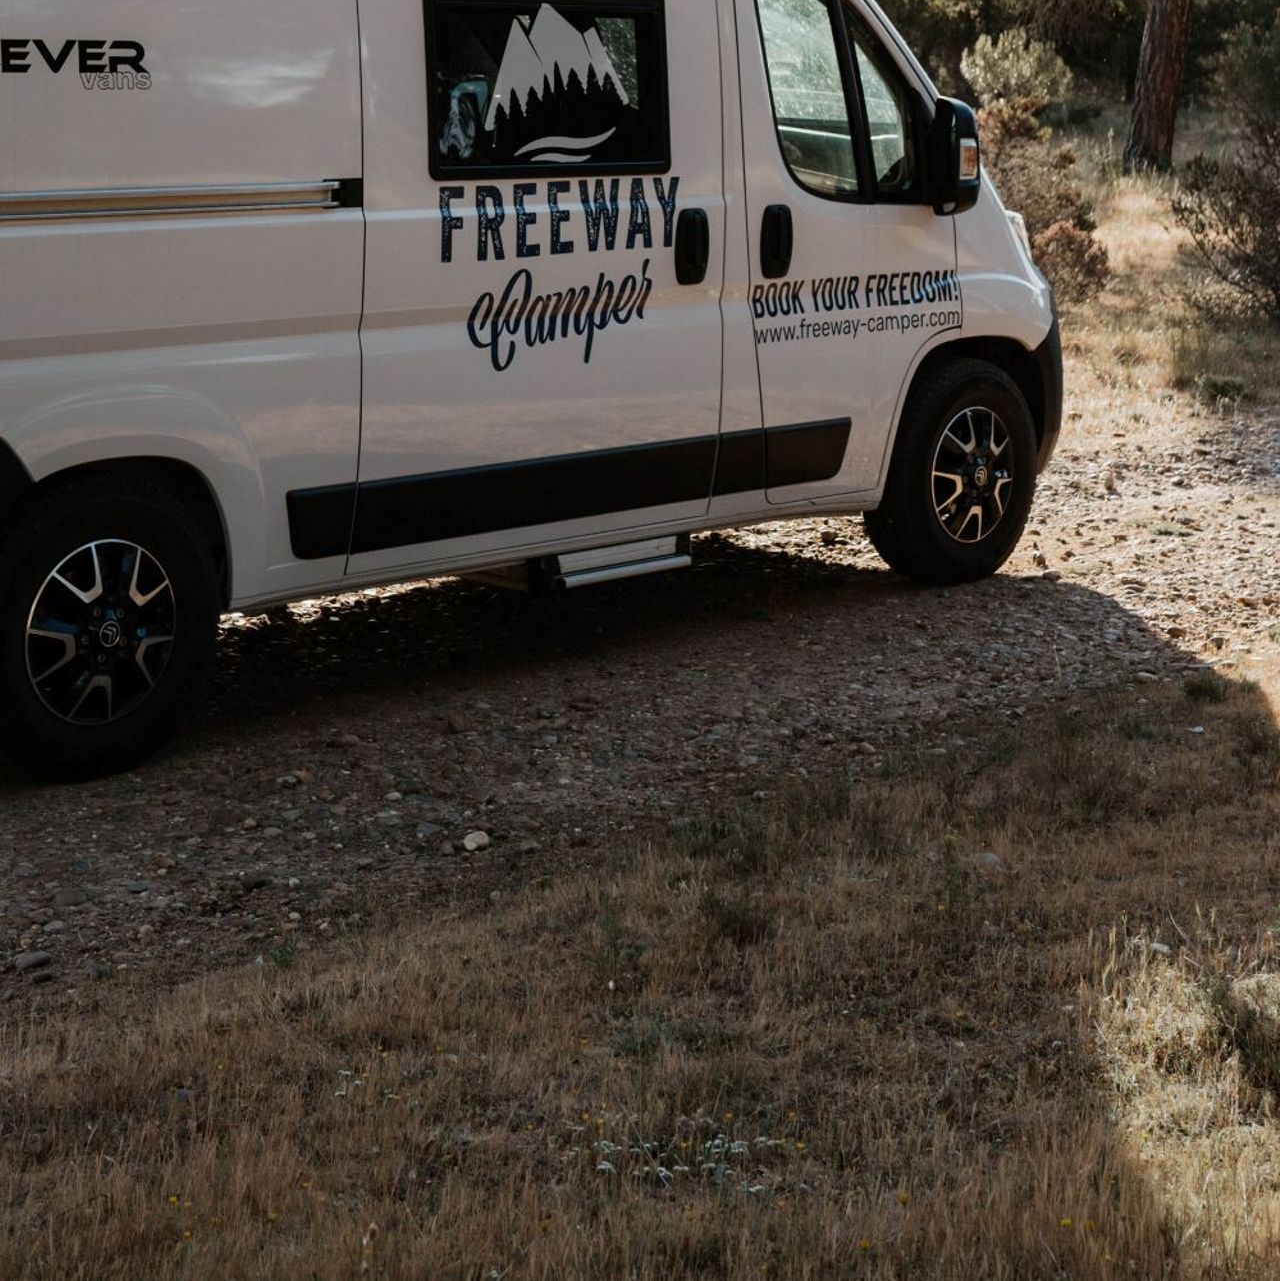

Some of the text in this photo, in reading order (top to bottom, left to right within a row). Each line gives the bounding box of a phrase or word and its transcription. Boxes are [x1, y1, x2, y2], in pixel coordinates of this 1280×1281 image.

[79, 71, 152, 90] vans
[439, 176, 680, 263] FREEWAY
[467, 258, 652, 372] Camper
[752, 269, 959, 319] BOOK YOUR FREEDOM!
[754, 310, 960, 344] www.freeway-camper.com
